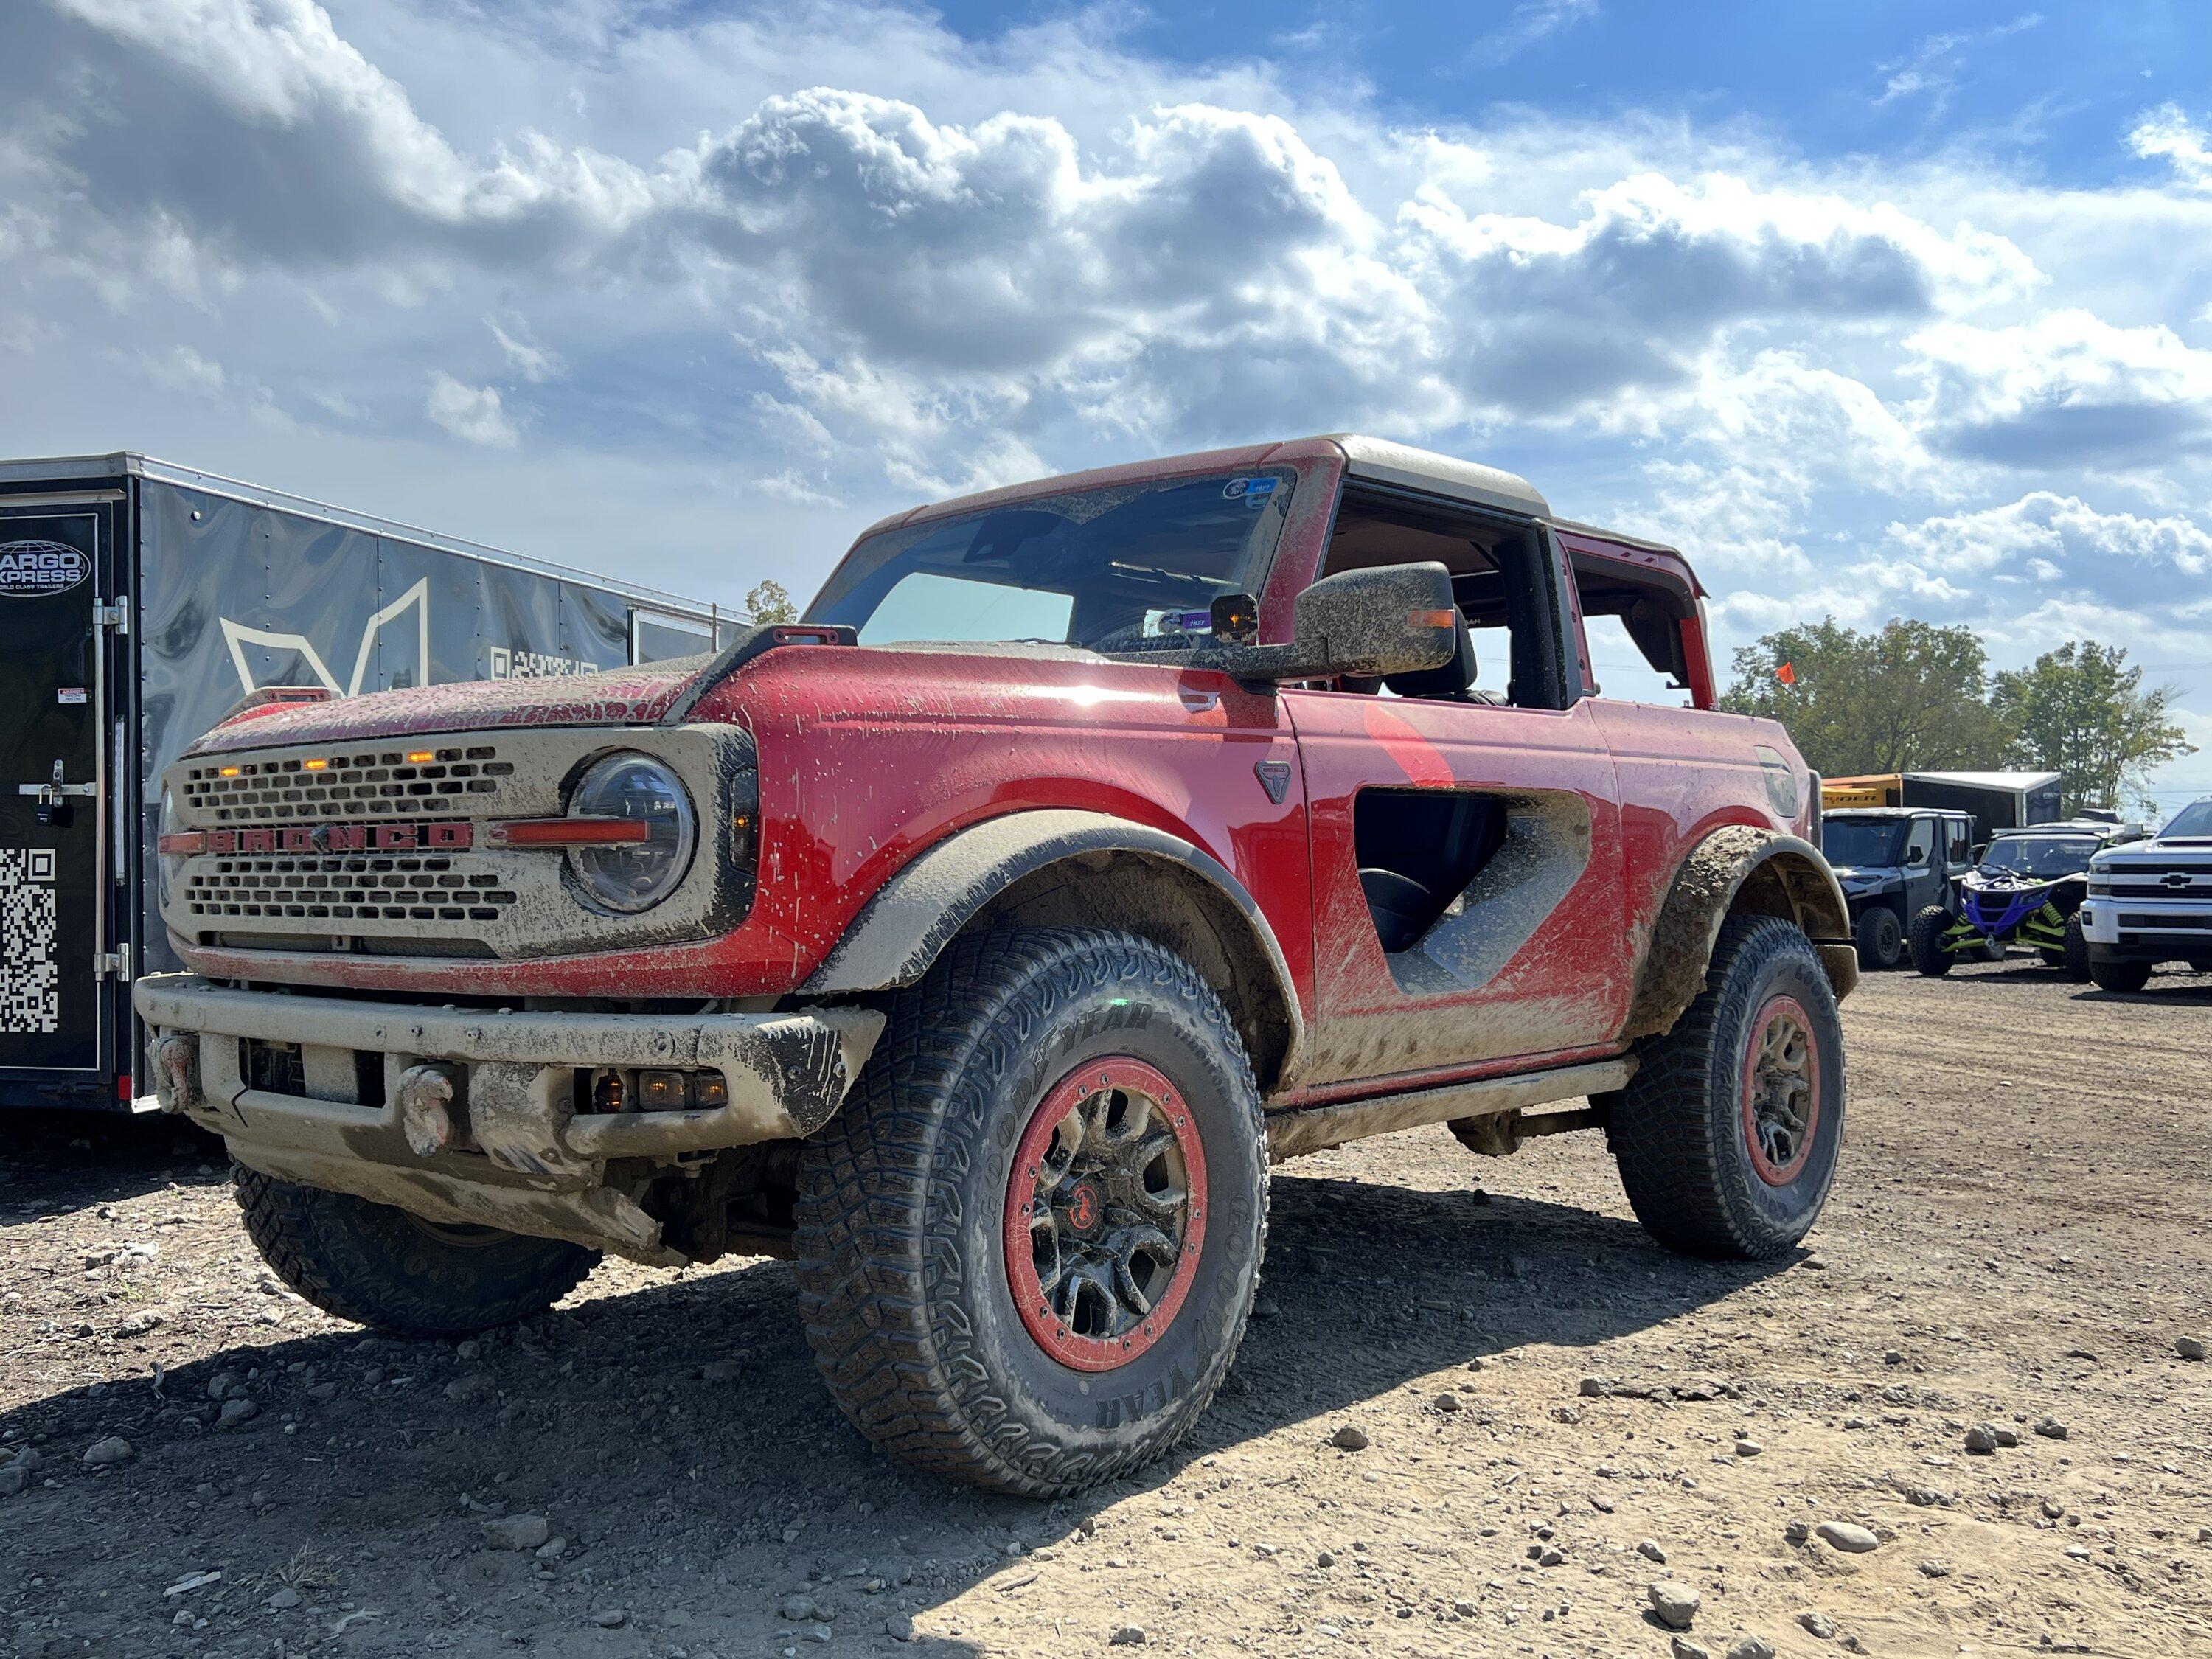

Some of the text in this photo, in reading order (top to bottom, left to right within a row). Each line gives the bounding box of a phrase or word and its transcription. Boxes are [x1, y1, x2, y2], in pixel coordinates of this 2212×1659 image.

[0, 553, 80, 570] ARGO
[0, 569, 81, 583] XPRESS
[209, 822, 474, 854] BRONCO
